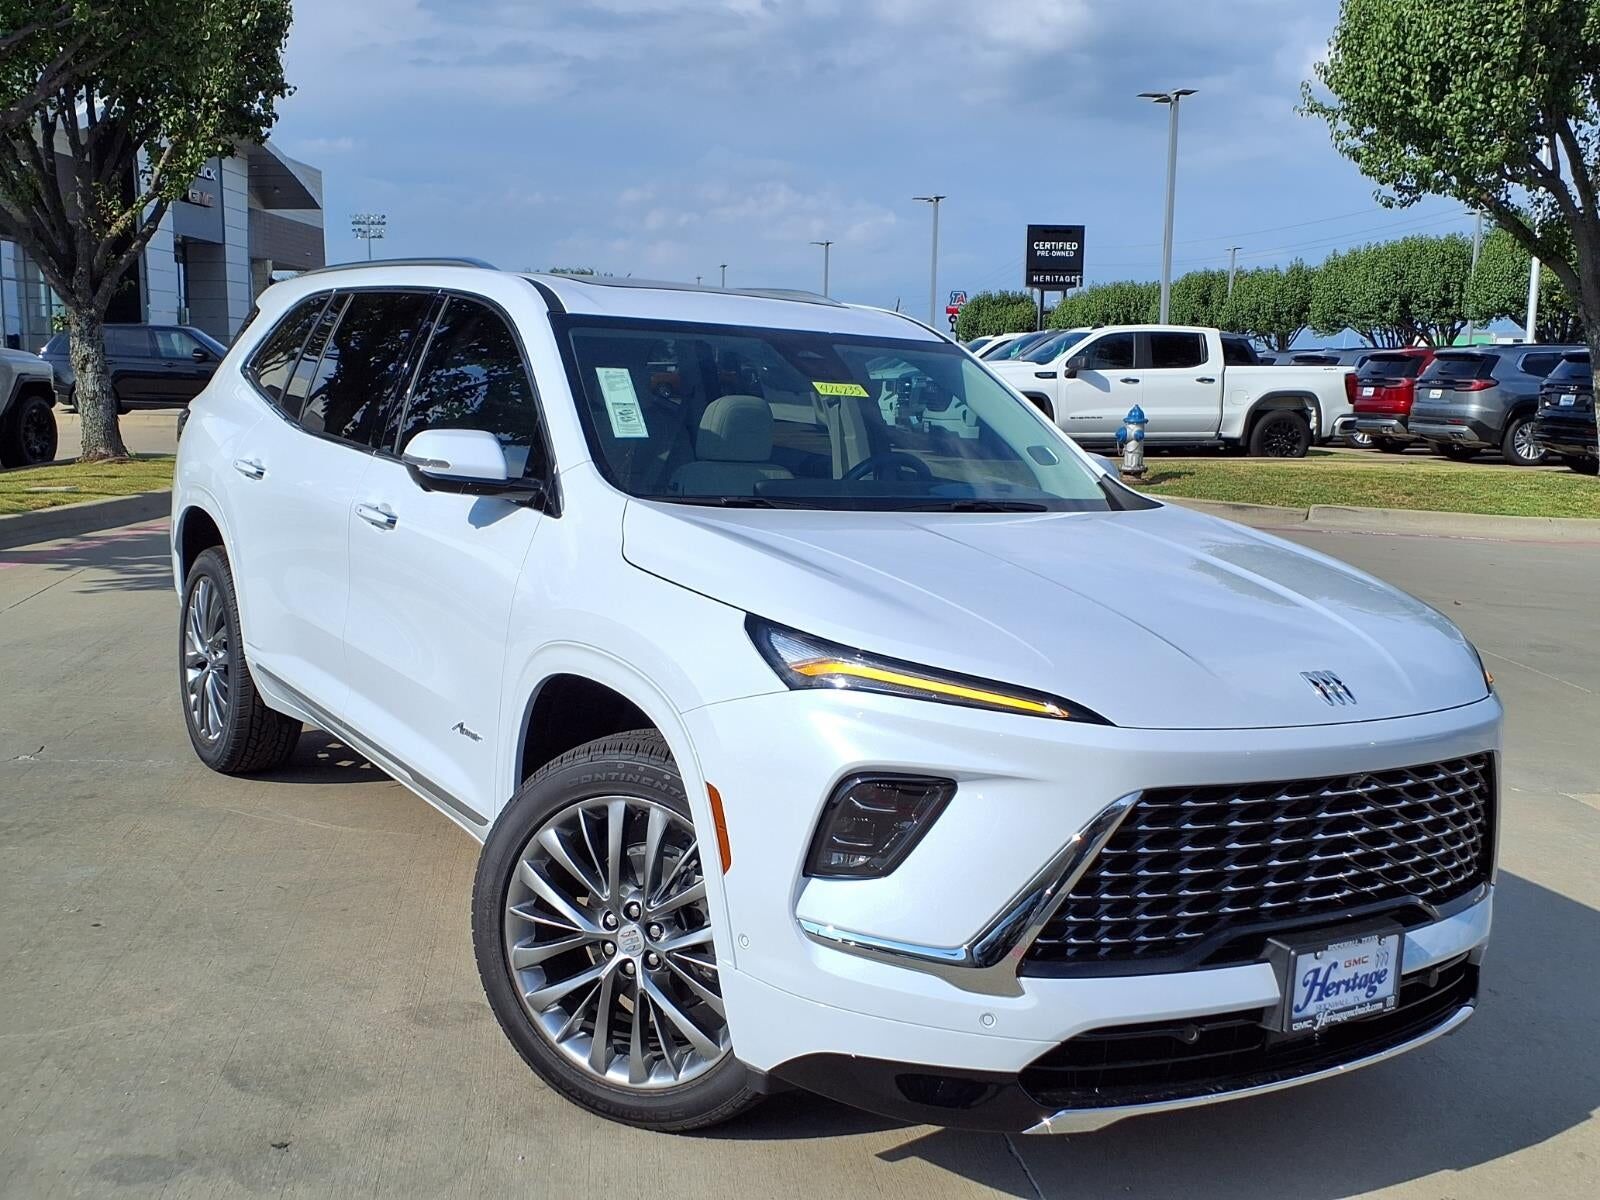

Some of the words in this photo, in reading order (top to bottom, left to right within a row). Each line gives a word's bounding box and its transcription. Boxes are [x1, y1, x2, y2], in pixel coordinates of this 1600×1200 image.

[1033, 241, 1078, 250] CERTIFIED
[1033, 275, 1077, 283] HERITAGE
[1344, 955, 1369, 968] GMC
[1294, 961, 1388, 1013] Heritage
[1292, 1019, 1313, 1031] GMC
